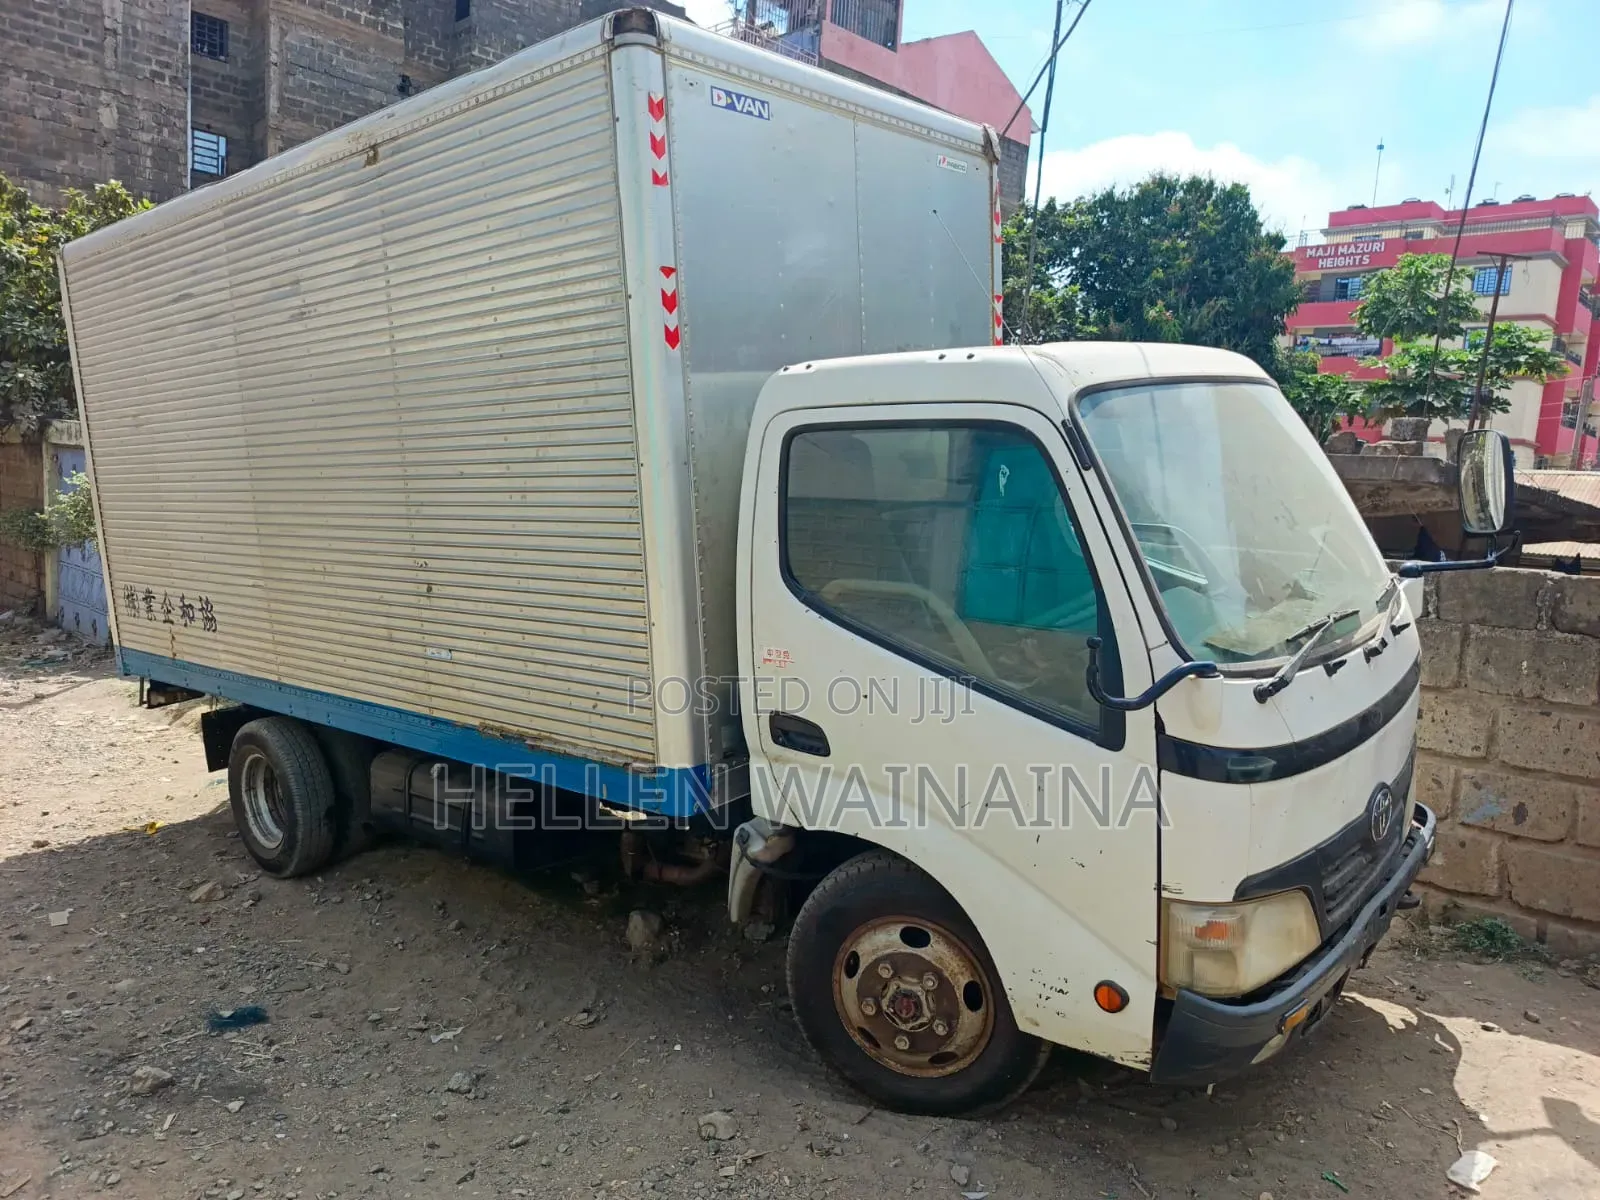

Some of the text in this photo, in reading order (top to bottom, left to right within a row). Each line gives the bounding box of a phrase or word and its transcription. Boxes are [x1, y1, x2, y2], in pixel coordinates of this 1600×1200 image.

[1306, 242, 1384, 258] MAJI MAZURI
[1318, 255, 1370, 268] HEIGHTS
